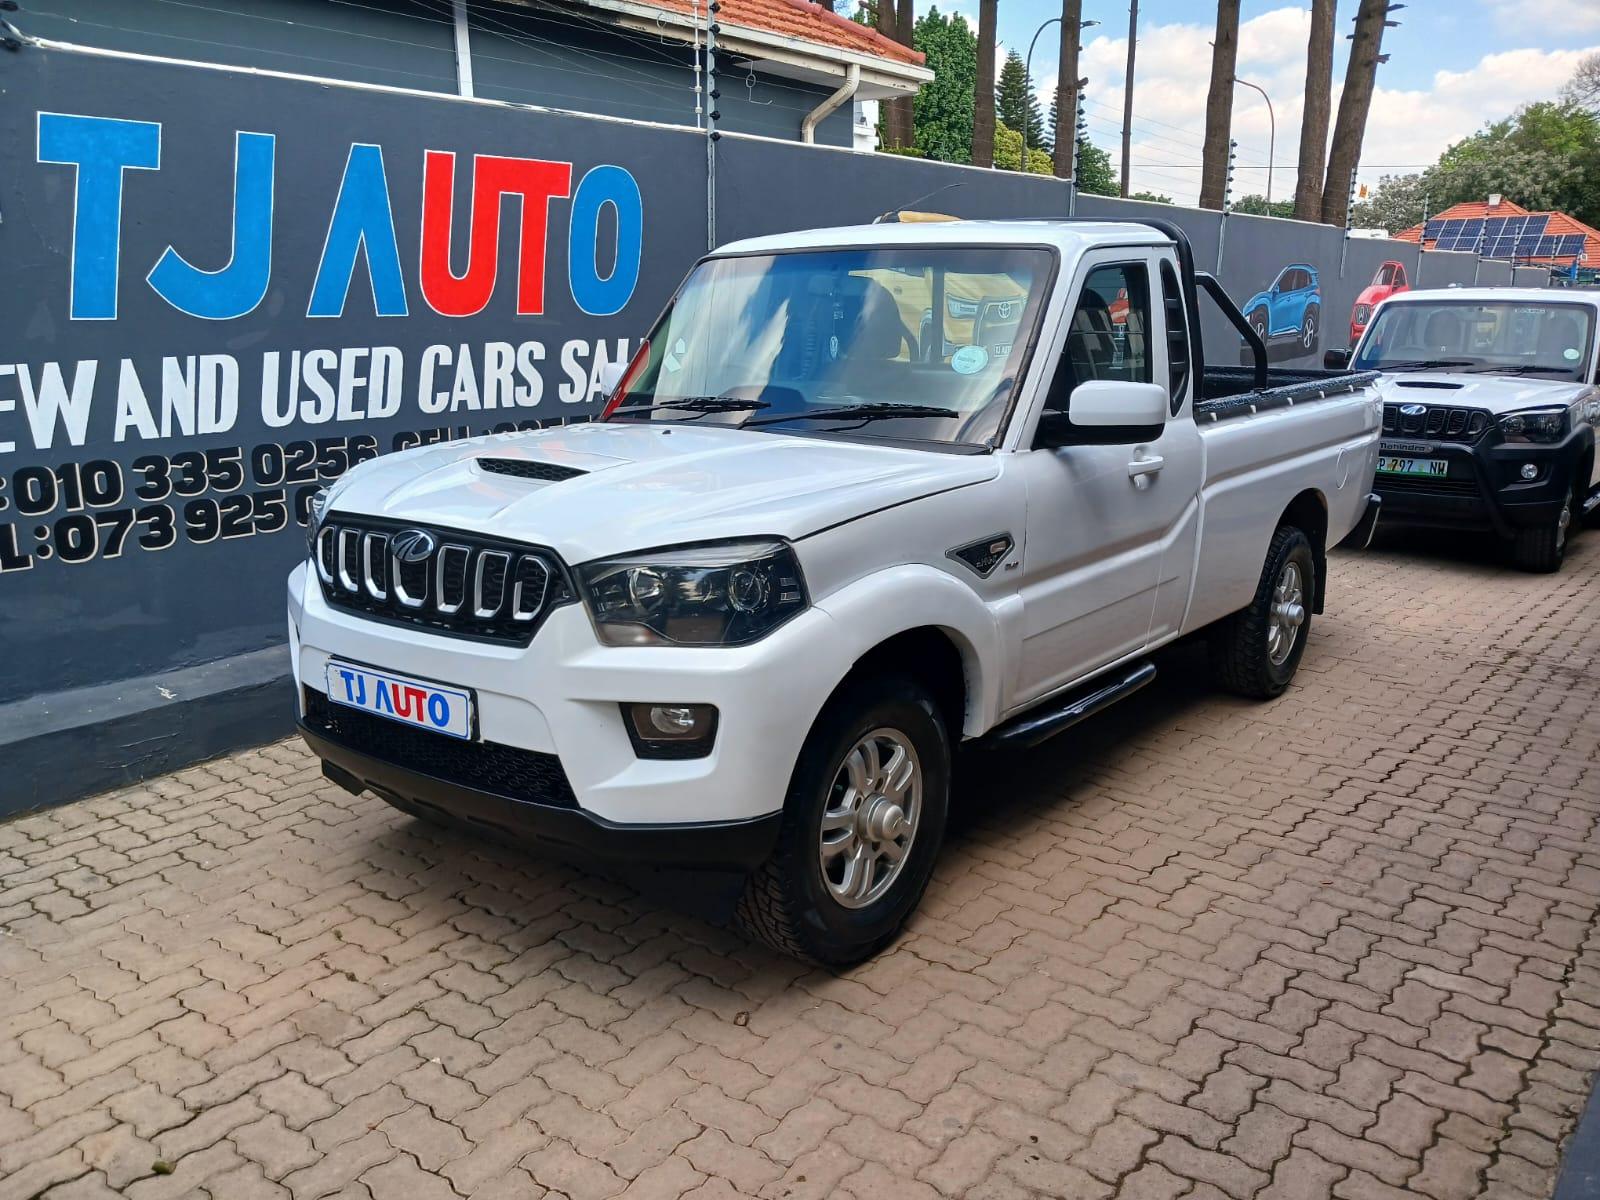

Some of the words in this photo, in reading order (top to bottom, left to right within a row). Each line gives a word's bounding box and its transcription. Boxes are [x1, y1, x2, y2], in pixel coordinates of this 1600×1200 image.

[37, 111, 276, 320] TJ
[306, 143, 643, 318] AUTO
[113, 354, 240, 442] AND
[260, 346, 404, 429] USED
[418, 341, 546, 414] CARS
[558, 337, 647, 403] SA
[132, 446, 245, 502] 335
[251, 434, 379, 487] 0256
[184, 489, 287, 544] 925
[340, 670, 367, 706] TJ
[375, 679, 451, 728] AUTO
